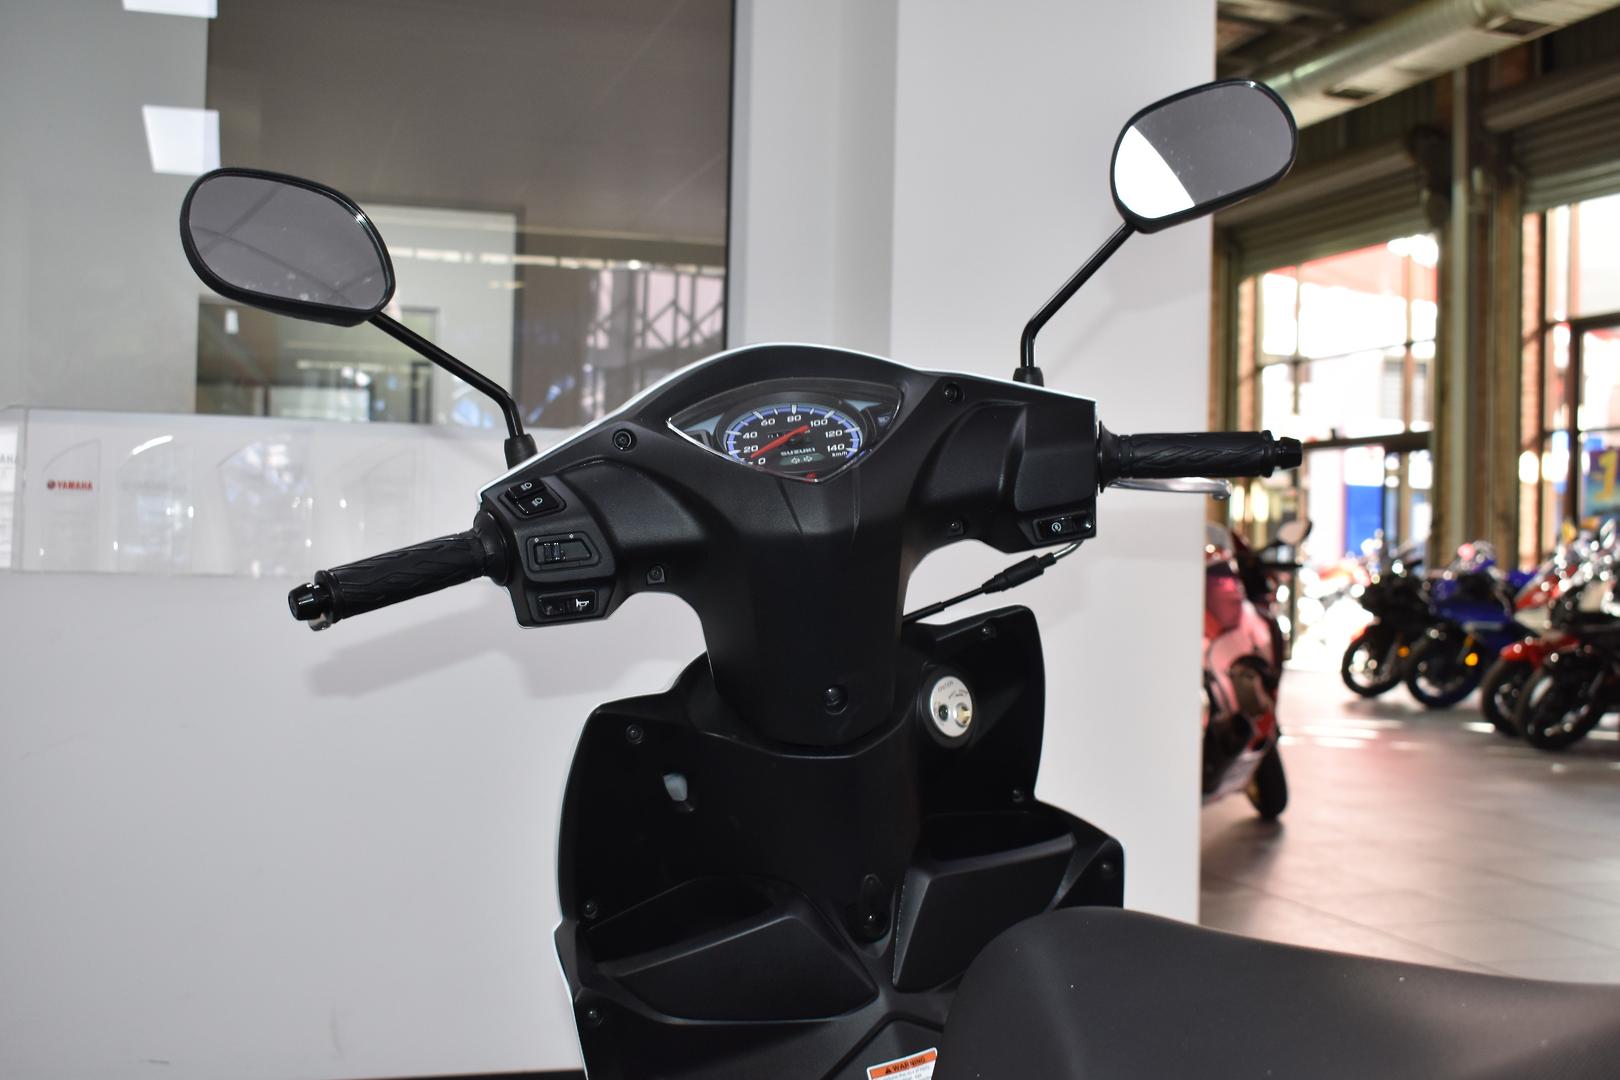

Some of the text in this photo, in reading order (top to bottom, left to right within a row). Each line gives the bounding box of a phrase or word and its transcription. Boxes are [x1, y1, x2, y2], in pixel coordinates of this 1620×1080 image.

[760, 418, 776, 427] 60
[787, 414, 802, 423] 80
[810, 418, 828, 427] 100
[742, 431, 758, 439] 40
[825, 429, 843, 438] 120
[743, 444, 759, 454] 20
[827, 443, 845, 452] 140
[758, 457, 766, 465] 0
[57, 480, 93, 491] YAMAHA
[892, 1056, 926, 1072] WARNING
